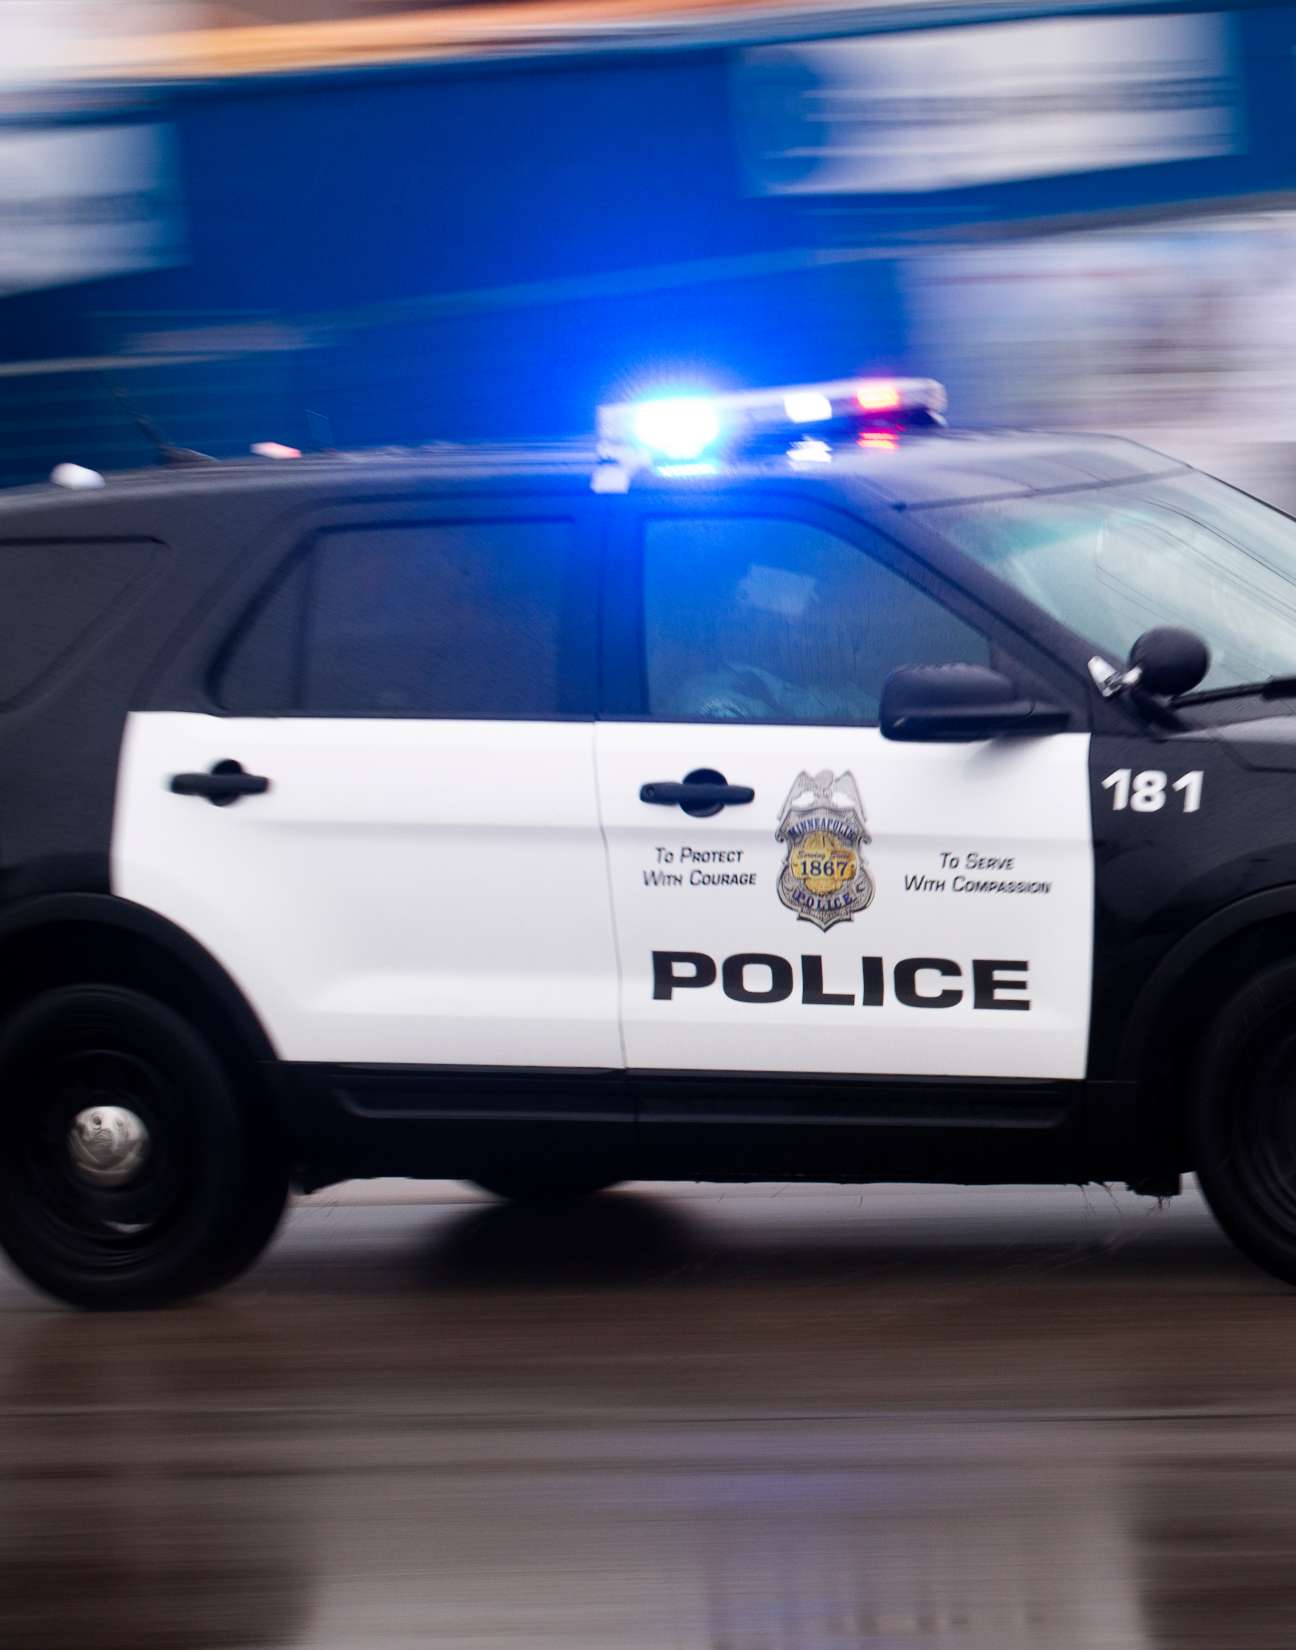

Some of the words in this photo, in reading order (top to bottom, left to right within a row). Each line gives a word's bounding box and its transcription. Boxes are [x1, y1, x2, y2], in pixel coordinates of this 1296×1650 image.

[1101, 768, 1204, 813] 181
[801, 860, 848, 877] 1867
[792, 889, 853, 911] POLICE
[652, 950, 1031, 1011] POLICE
